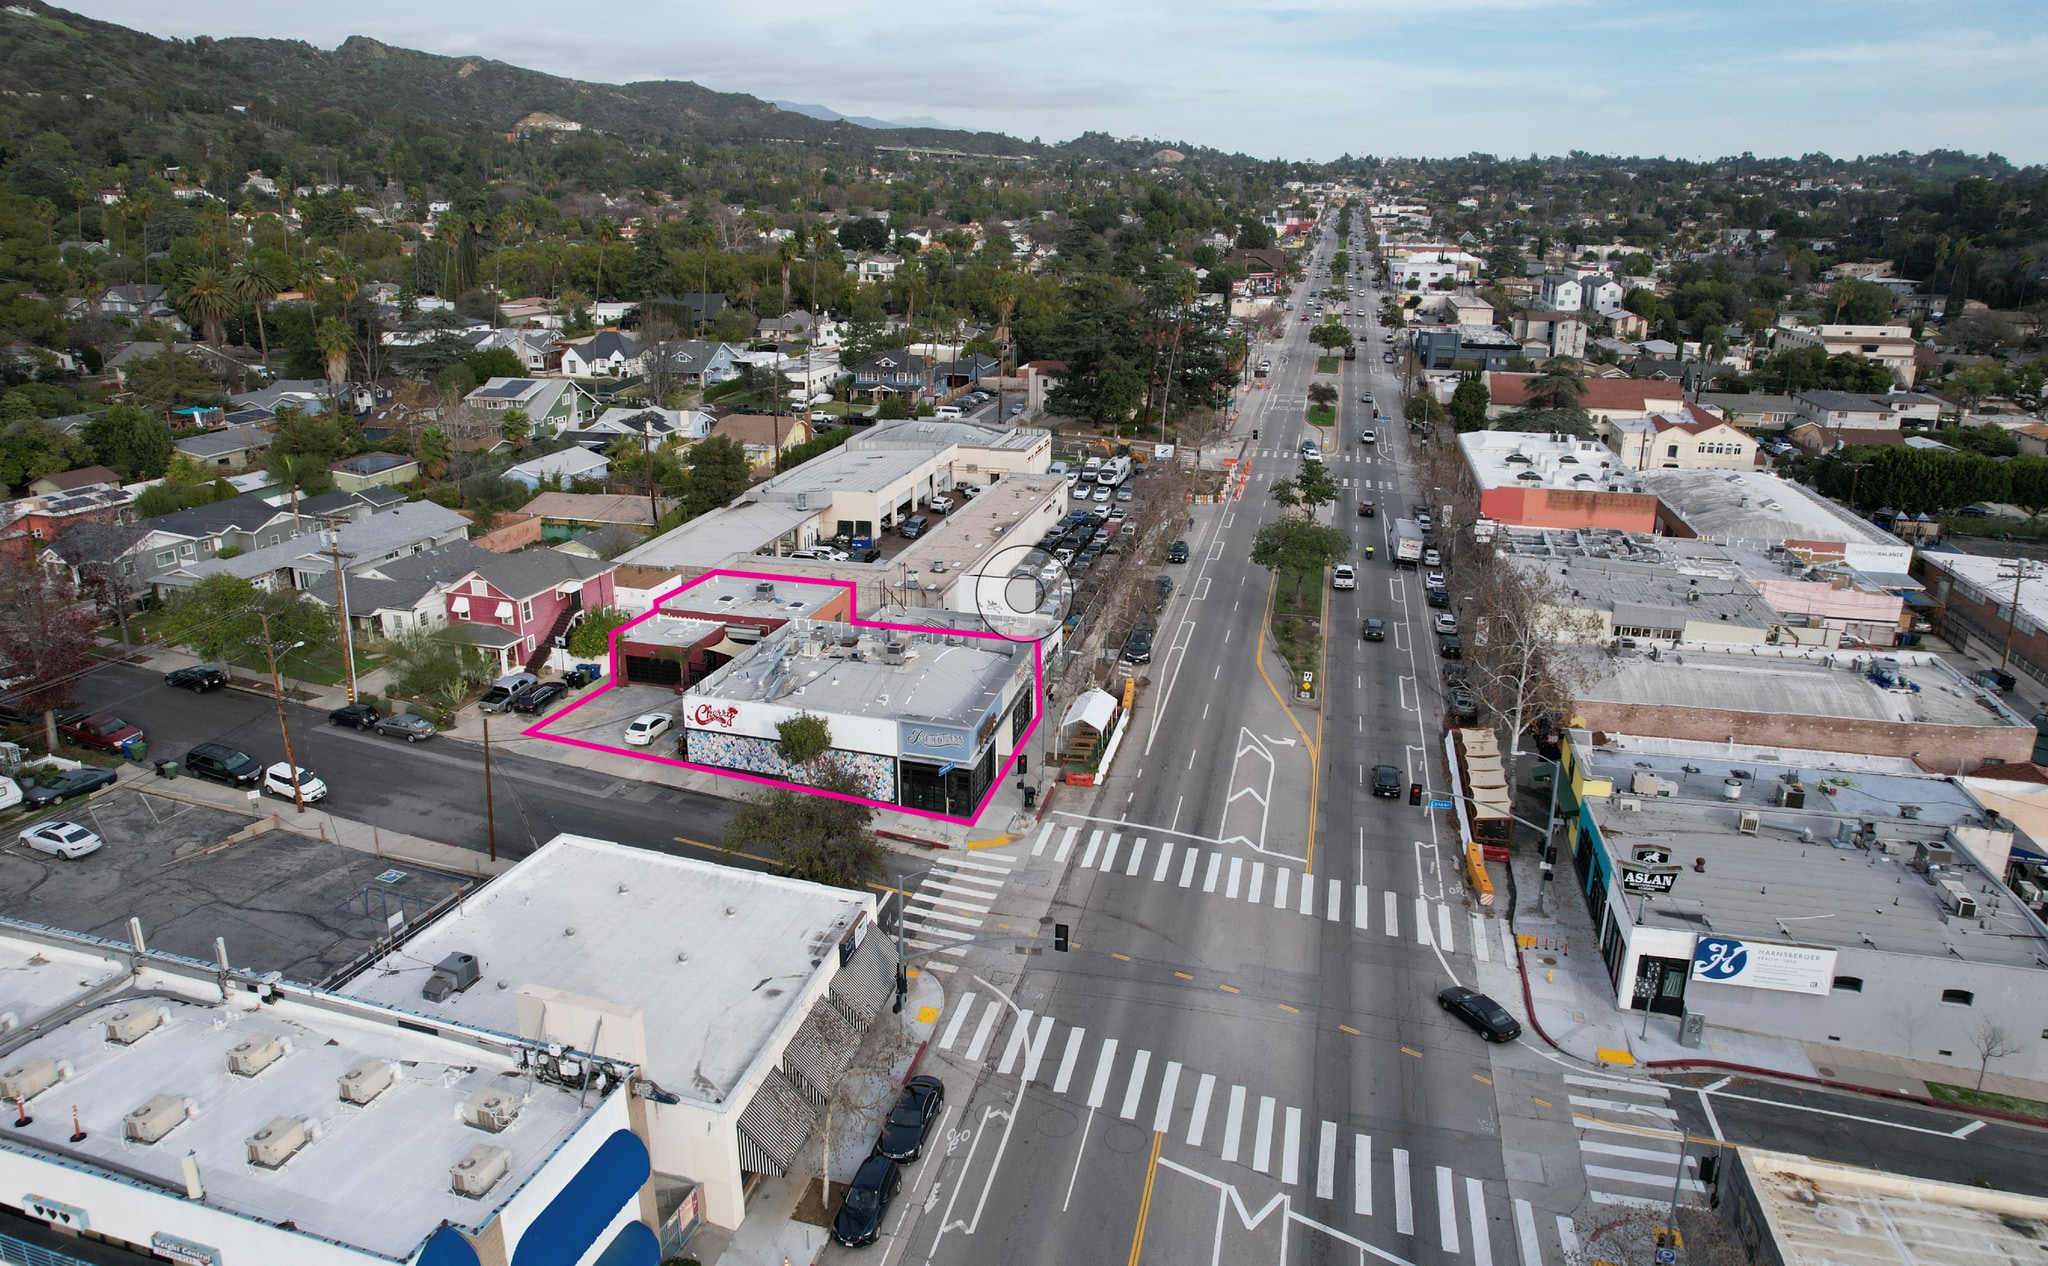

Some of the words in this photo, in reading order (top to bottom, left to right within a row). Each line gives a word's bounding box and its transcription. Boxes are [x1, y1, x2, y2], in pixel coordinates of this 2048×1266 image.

[695, 704, 737, 728] Cherry
[1624, 872, 1673, 886] ASLAN
[1758, 950, 1821, 961] HARNSBERGER
[154, 1239, 180, 1252] Weight
[181, 1247, 211, 1261] Control
